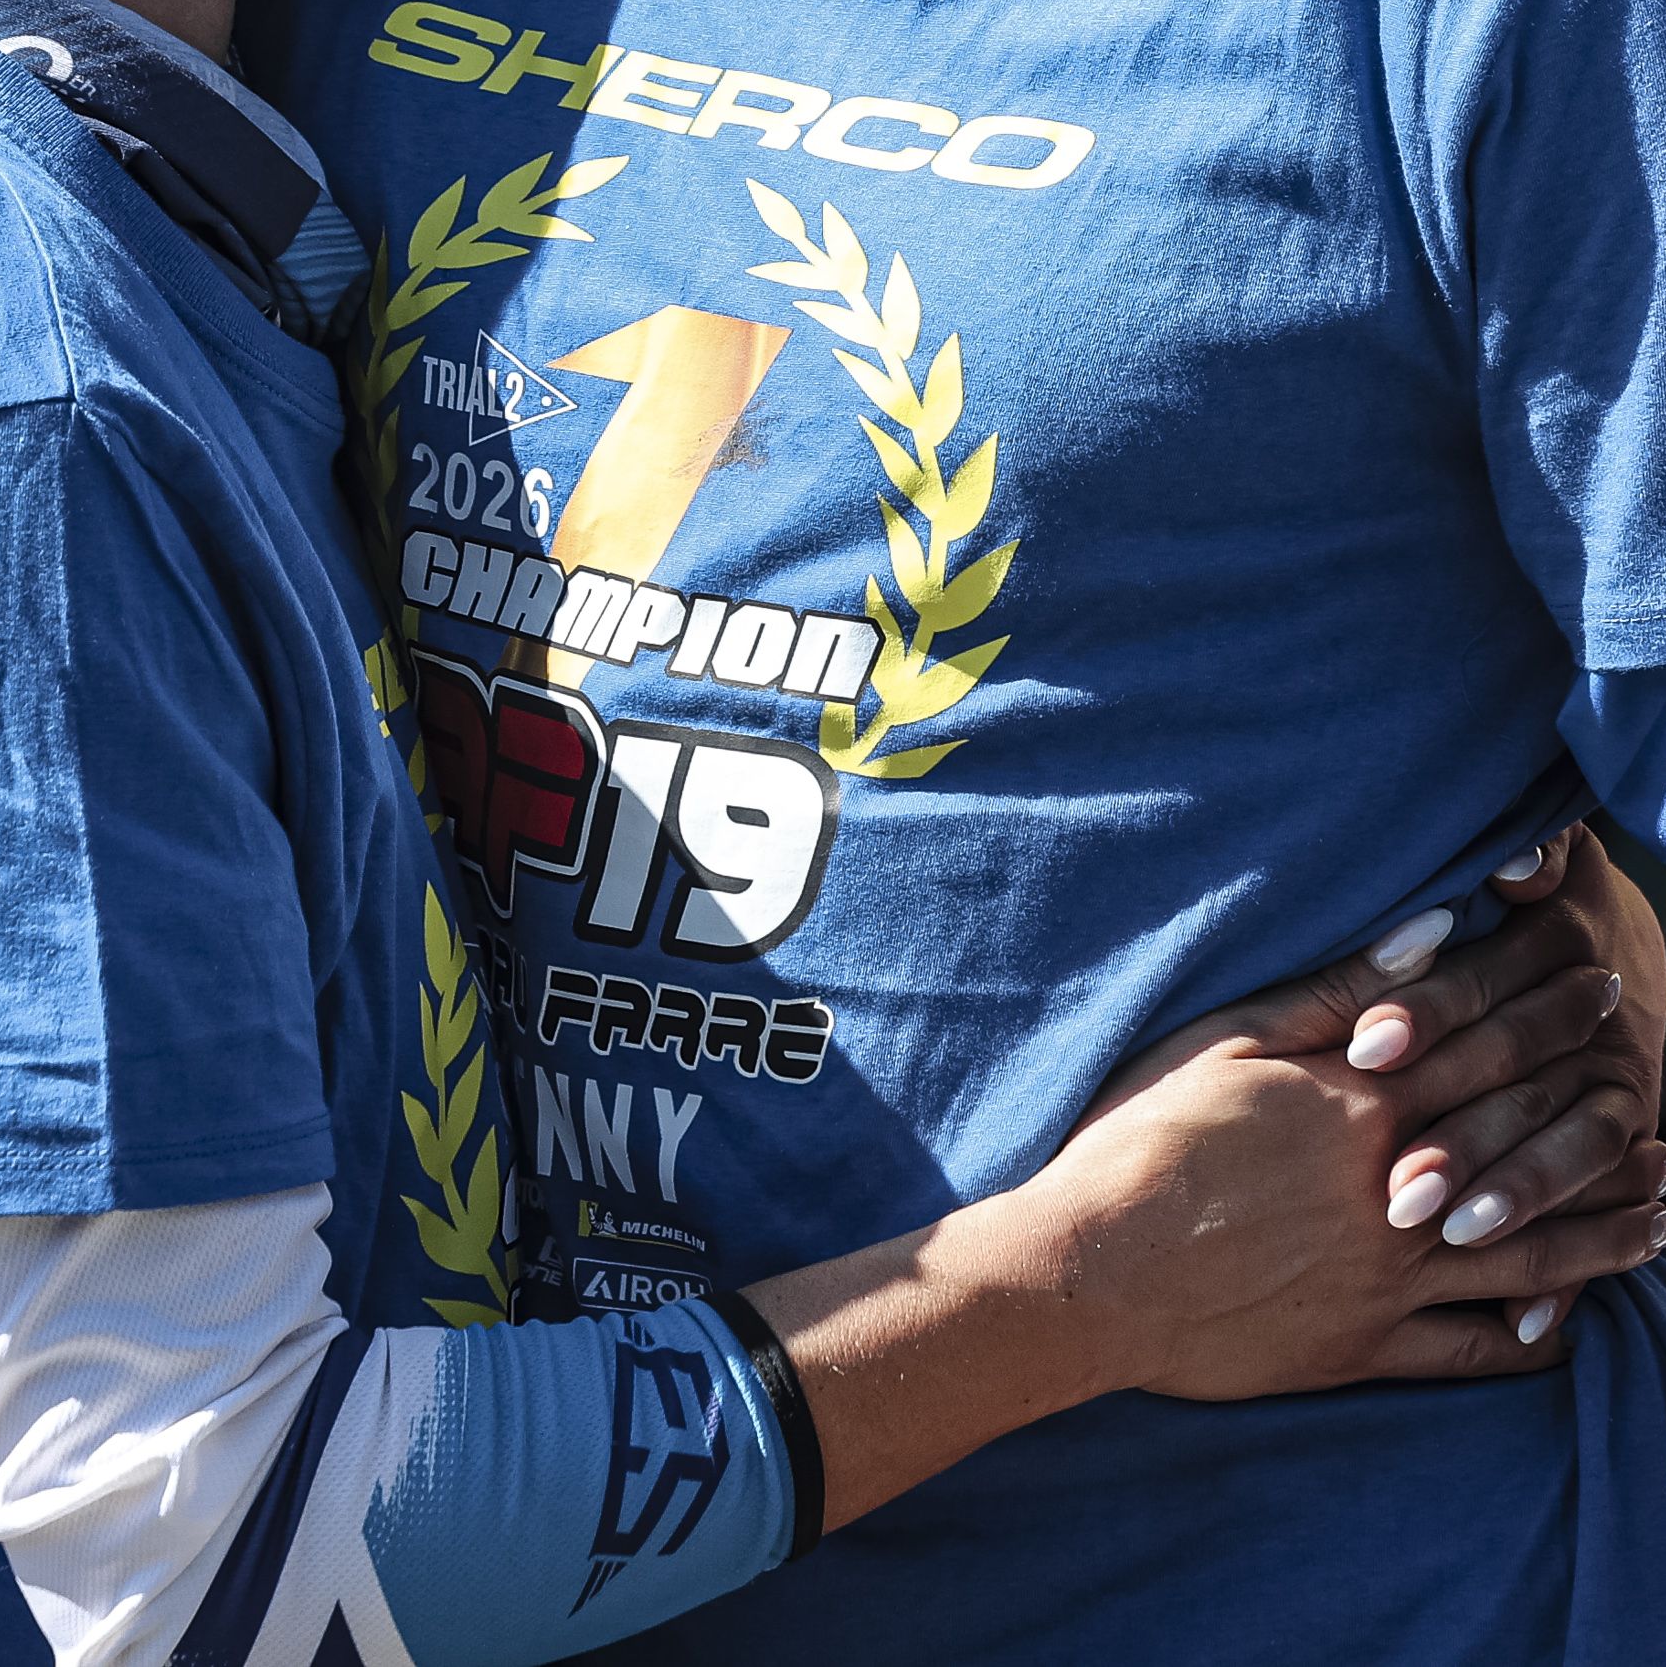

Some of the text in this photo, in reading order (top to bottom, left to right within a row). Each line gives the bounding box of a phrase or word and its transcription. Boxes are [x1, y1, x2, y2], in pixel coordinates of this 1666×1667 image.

[367, 0, 1097, 190] SHERCO
[408, 442, 554, 539] 2026
[399, 527, 885, 704] CHAMPION
[514, 1055, 703, 1204] NNY
[621, 1220, 706, 1253] MICHELIN
